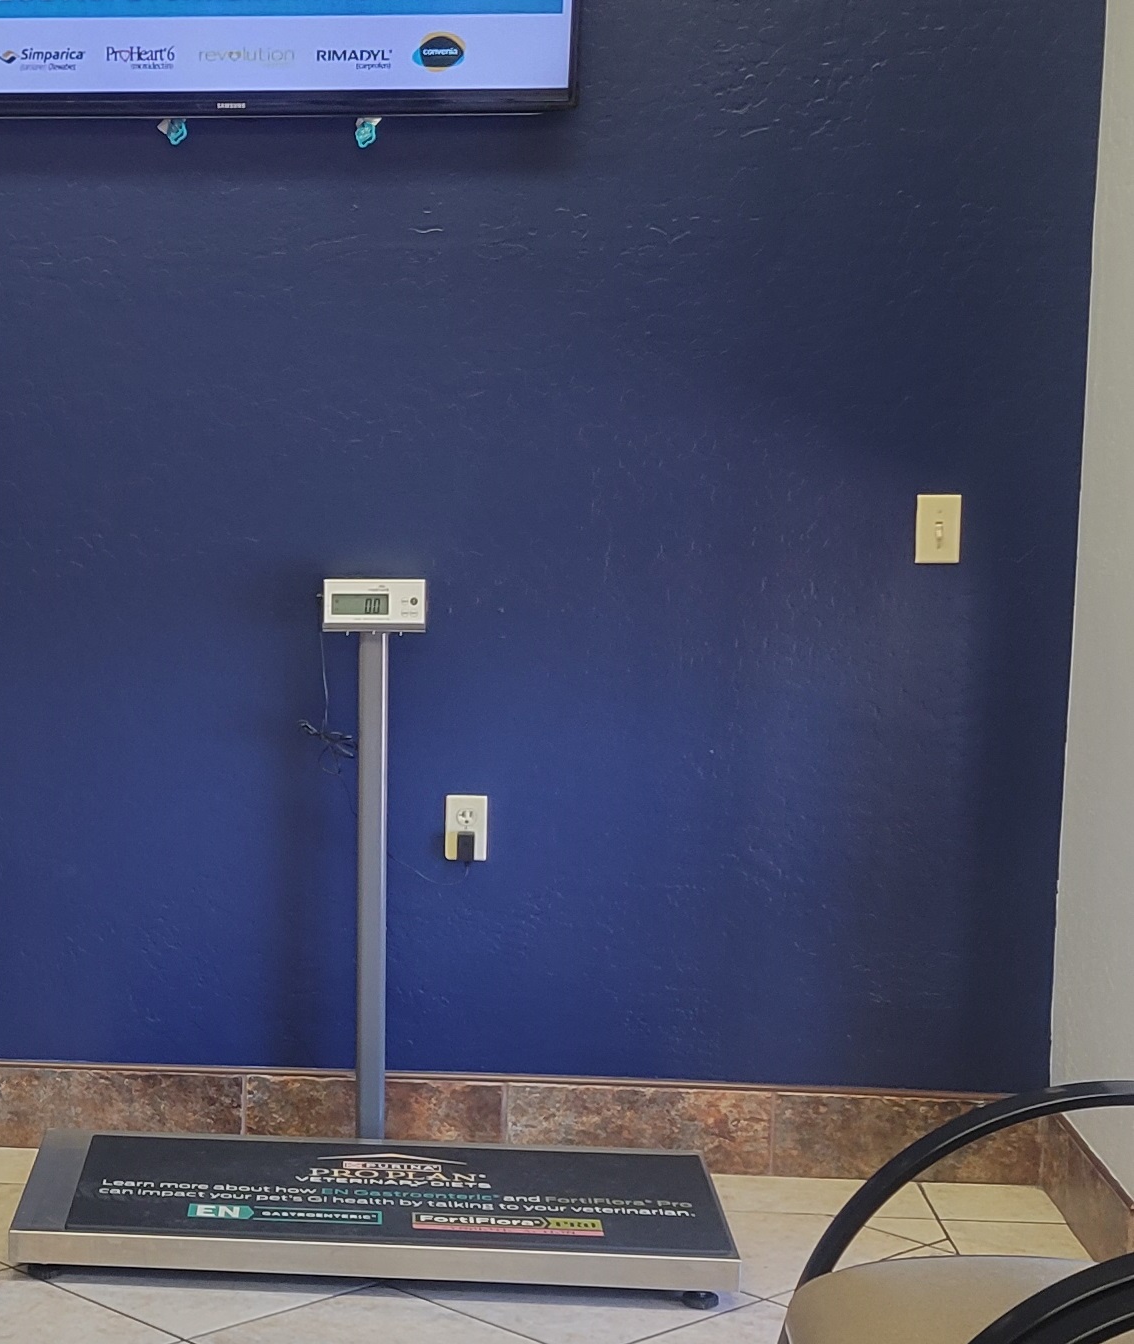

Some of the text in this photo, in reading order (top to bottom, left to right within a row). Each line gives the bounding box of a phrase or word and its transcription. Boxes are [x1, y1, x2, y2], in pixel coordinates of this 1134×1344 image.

[20, 47, 84, 63] Simparica
[198, 47, 295, 62] revolution
[316, 49, 390, 62] RIMADYL
[422, 47, 458, 56] convenia
[366, 1163, 436, 1171] PURINA
[309, 1167, 477, 1182] PRO PLAN
[295, 1175, 491, 1189] VETERINARY DIETS
[102, 1178, 155, 1188] Learn
[159, 1182, 209, 1190] more
[213, 1183, 270, 1193] about
[275, 1185, 317, 1194] how
[321, 1187, 349, 1196] EN
[503, 1195, 540, 1203] and
[656, 1200, 693, 1208] Pro
[98, 1187, 134, 1195] can
[137, 1188, 206, 1198] impact
[209, 1192, 252, 1201] your
[255, 1194, 303, 1203] pet's
[332, 1196, 395, 1206] health
[399, 1198, 424, 1208] by
[427, 1200, 495, 1211] talking
[499, 1203, 519, 1211] to
[522, 1205, 567, 1213] your
[570, 1206, 696, 1218] veterinarian.
[195, 1205, 242, 1218] EN
